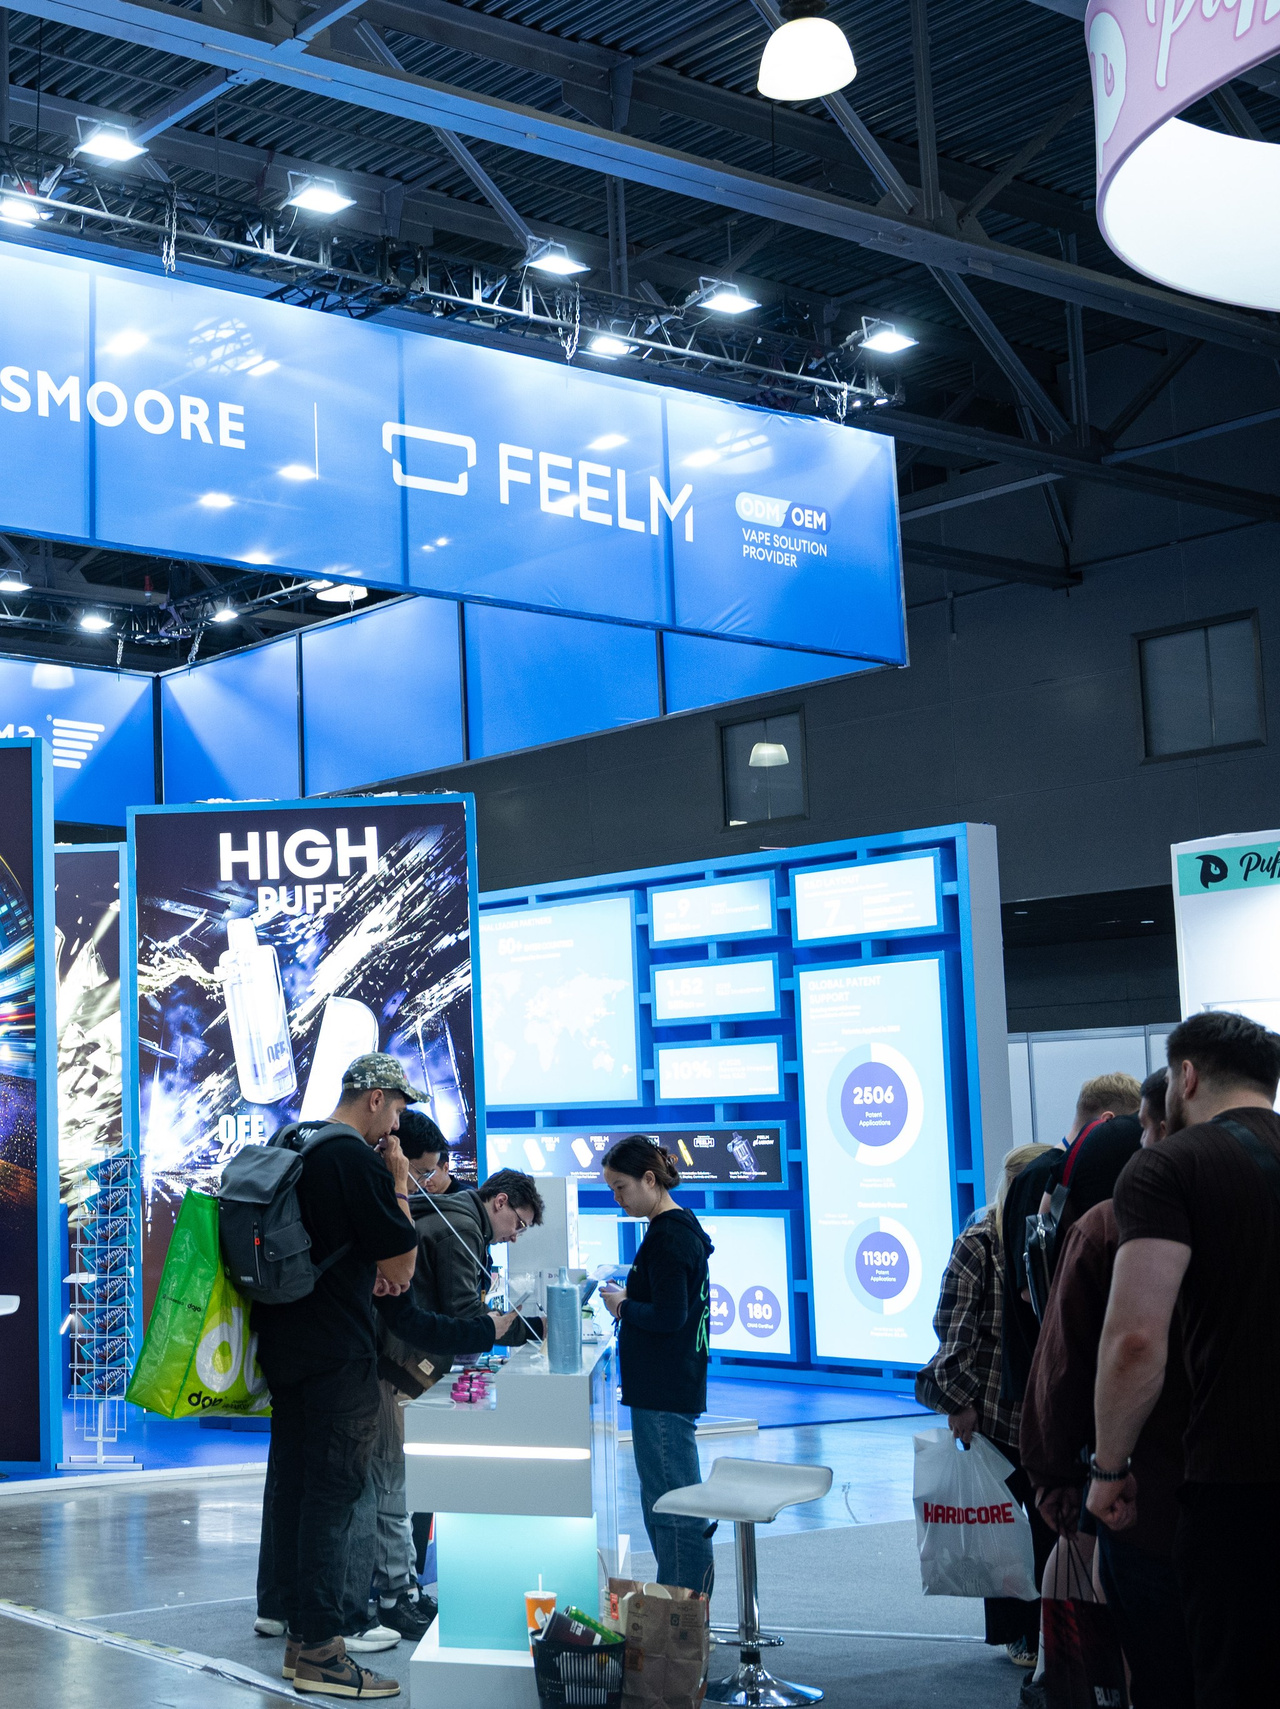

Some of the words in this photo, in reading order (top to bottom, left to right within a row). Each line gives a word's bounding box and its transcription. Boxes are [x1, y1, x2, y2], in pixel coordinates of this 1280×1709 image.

[0, 365, 246, 450] SMOORE
[499, 442, 694, 542] FEELM
[741, 497, 780, 522] ODM
[791, 507, 826, 531] OEM
[742, 527, 770, 546] VAPE
[773, 534, 827, 557] SOLUTION
[743, 544, 797, 568] PROVIDER
[219, 826, 379, 881] HIGH
[257, 883, 344, 914] PUFF
[853, 1085, 894, 1105] 2506
[859, 1119, 891, 1127] Applications
[862, 1250, 899, 1266] 11309
[746, 1302, 773, 1320] 180
[923, 1501, 1015, 1525] HARDCORE
